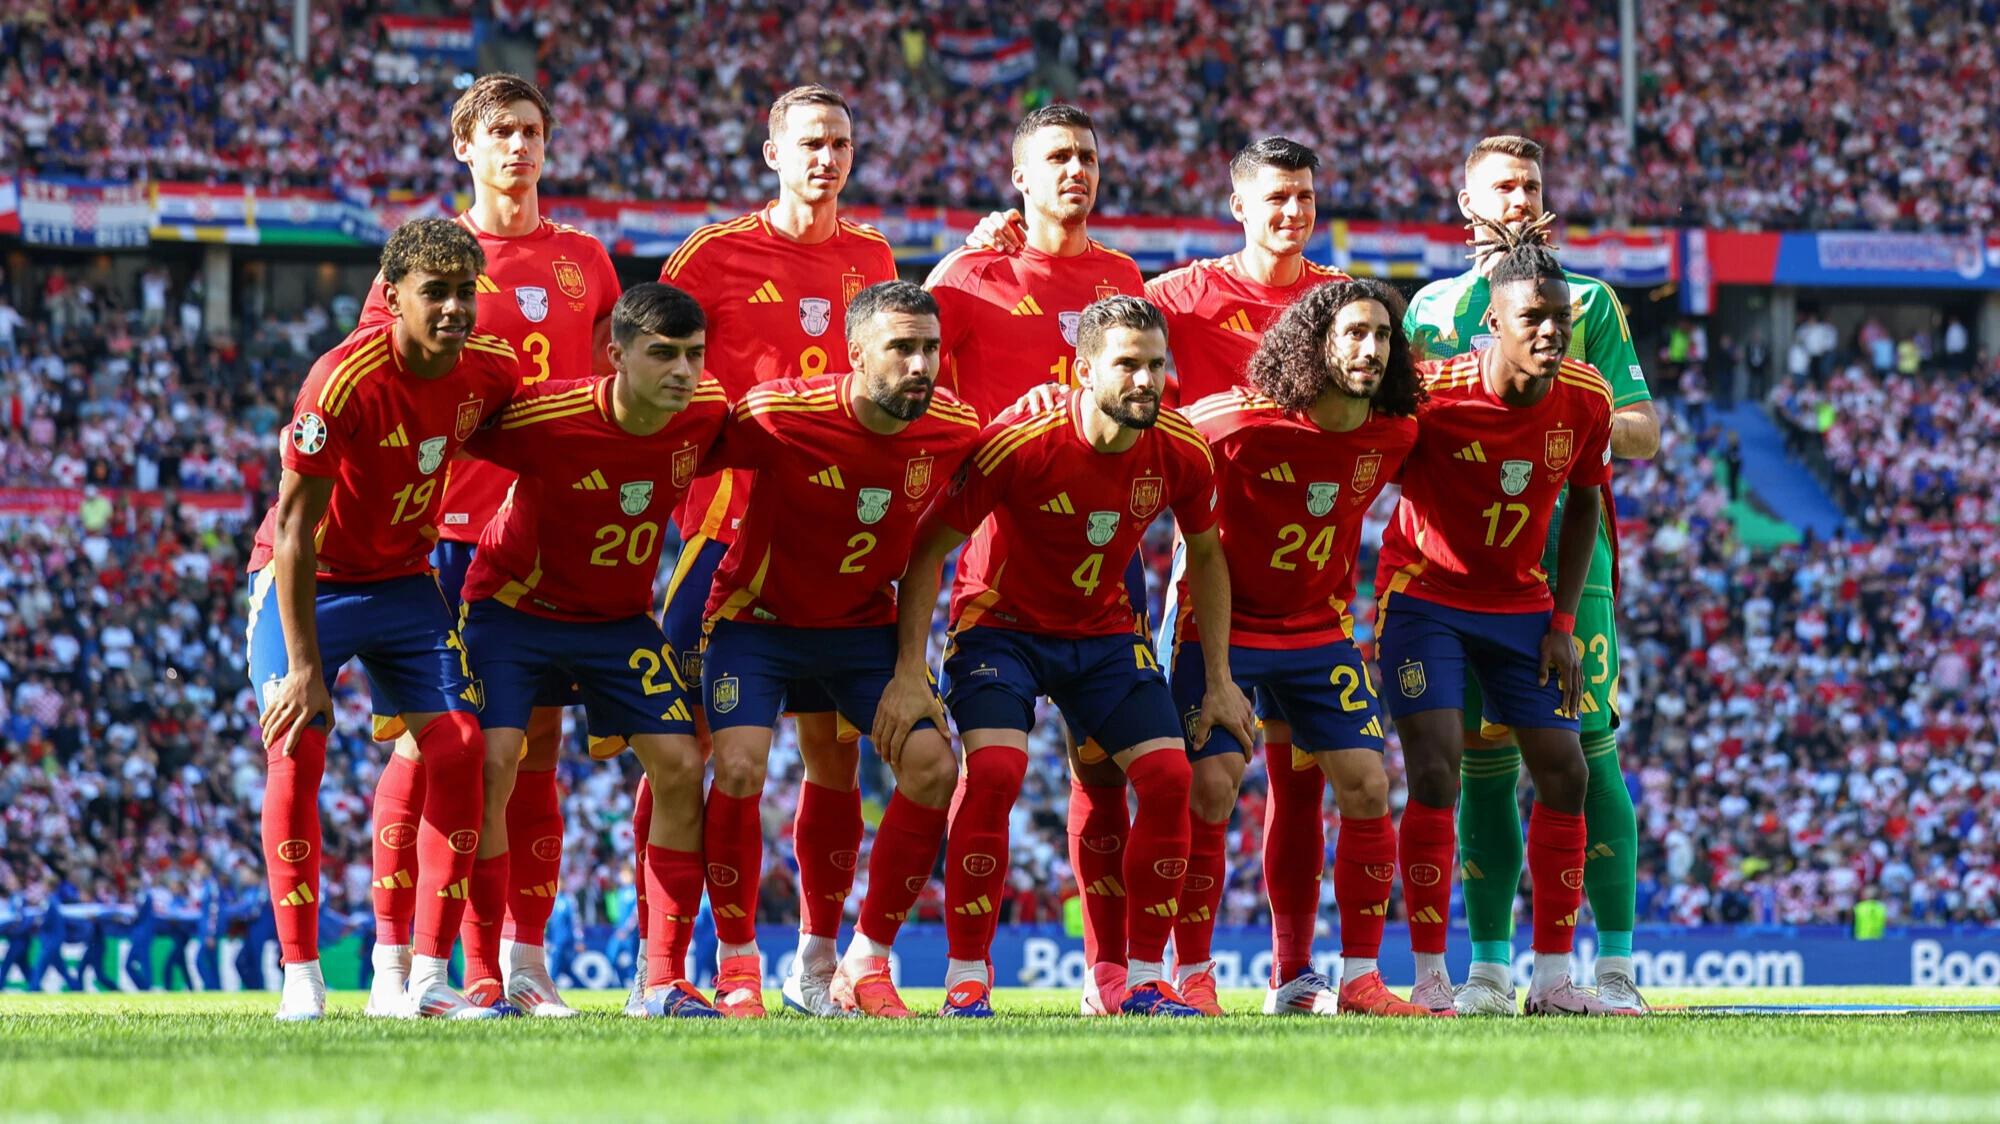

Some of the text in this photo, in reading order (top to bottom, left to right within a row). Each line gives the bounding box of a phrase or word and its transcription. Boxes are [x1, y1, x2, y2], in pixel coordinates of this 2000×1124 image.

[522, 332, 550, 385] 3
[1050, 356, 1081, 390] 1
[390, 478, 437, 526] 19
[1482, 502, 1530, 547] 17
[590, 521, 659, 566] 20
[839, 532, 877, 573] 2
[1270, 523, 1336, 571] 24
[1071, 553, 1105, 596] 4
